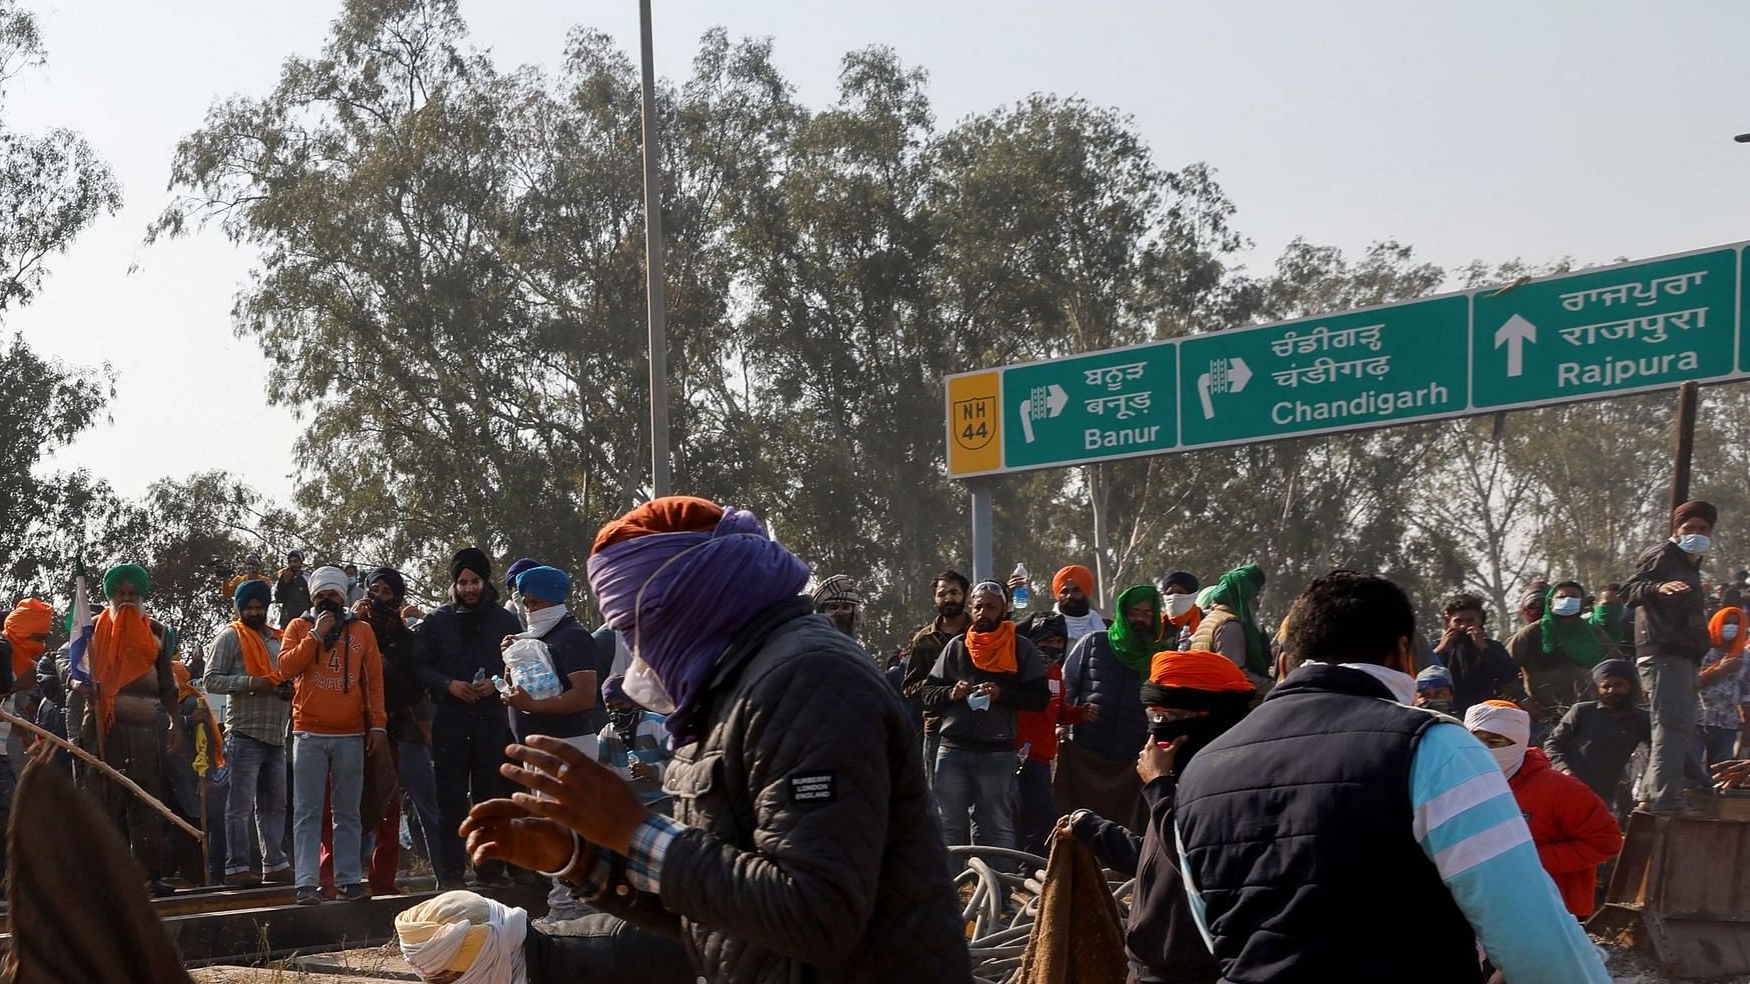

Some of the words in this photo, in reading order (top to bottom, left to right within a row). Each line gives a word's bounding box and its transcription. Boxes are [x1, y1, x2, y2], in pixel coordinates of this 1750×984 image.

[1559, 271, 1709, 312] ਰਾਜਪੁਰਾ
[1558, 306, 1709, 346] राजपुरा
[1083, 361, 1148, 391] ਬਨੂੜ
[1271, 355, 1392, 388] चंडीगढ़
[1557, 350, 1699, 388] Rajpura
[963, 401, 986, 420] NH
[1084, 391, 1152, 420] बनूड़
[1271, 382, 1449, 425] Chandigarh
[962, 422, 988, 440] 44
[1084, 425, 1161, 450] Banur
[326, 648, 342, 673] 4
[791, 775, 832, 786] BURBERRY
[796, 783, 829, 792] LONDON
[795, 791, 831, 800] ENGLAND
